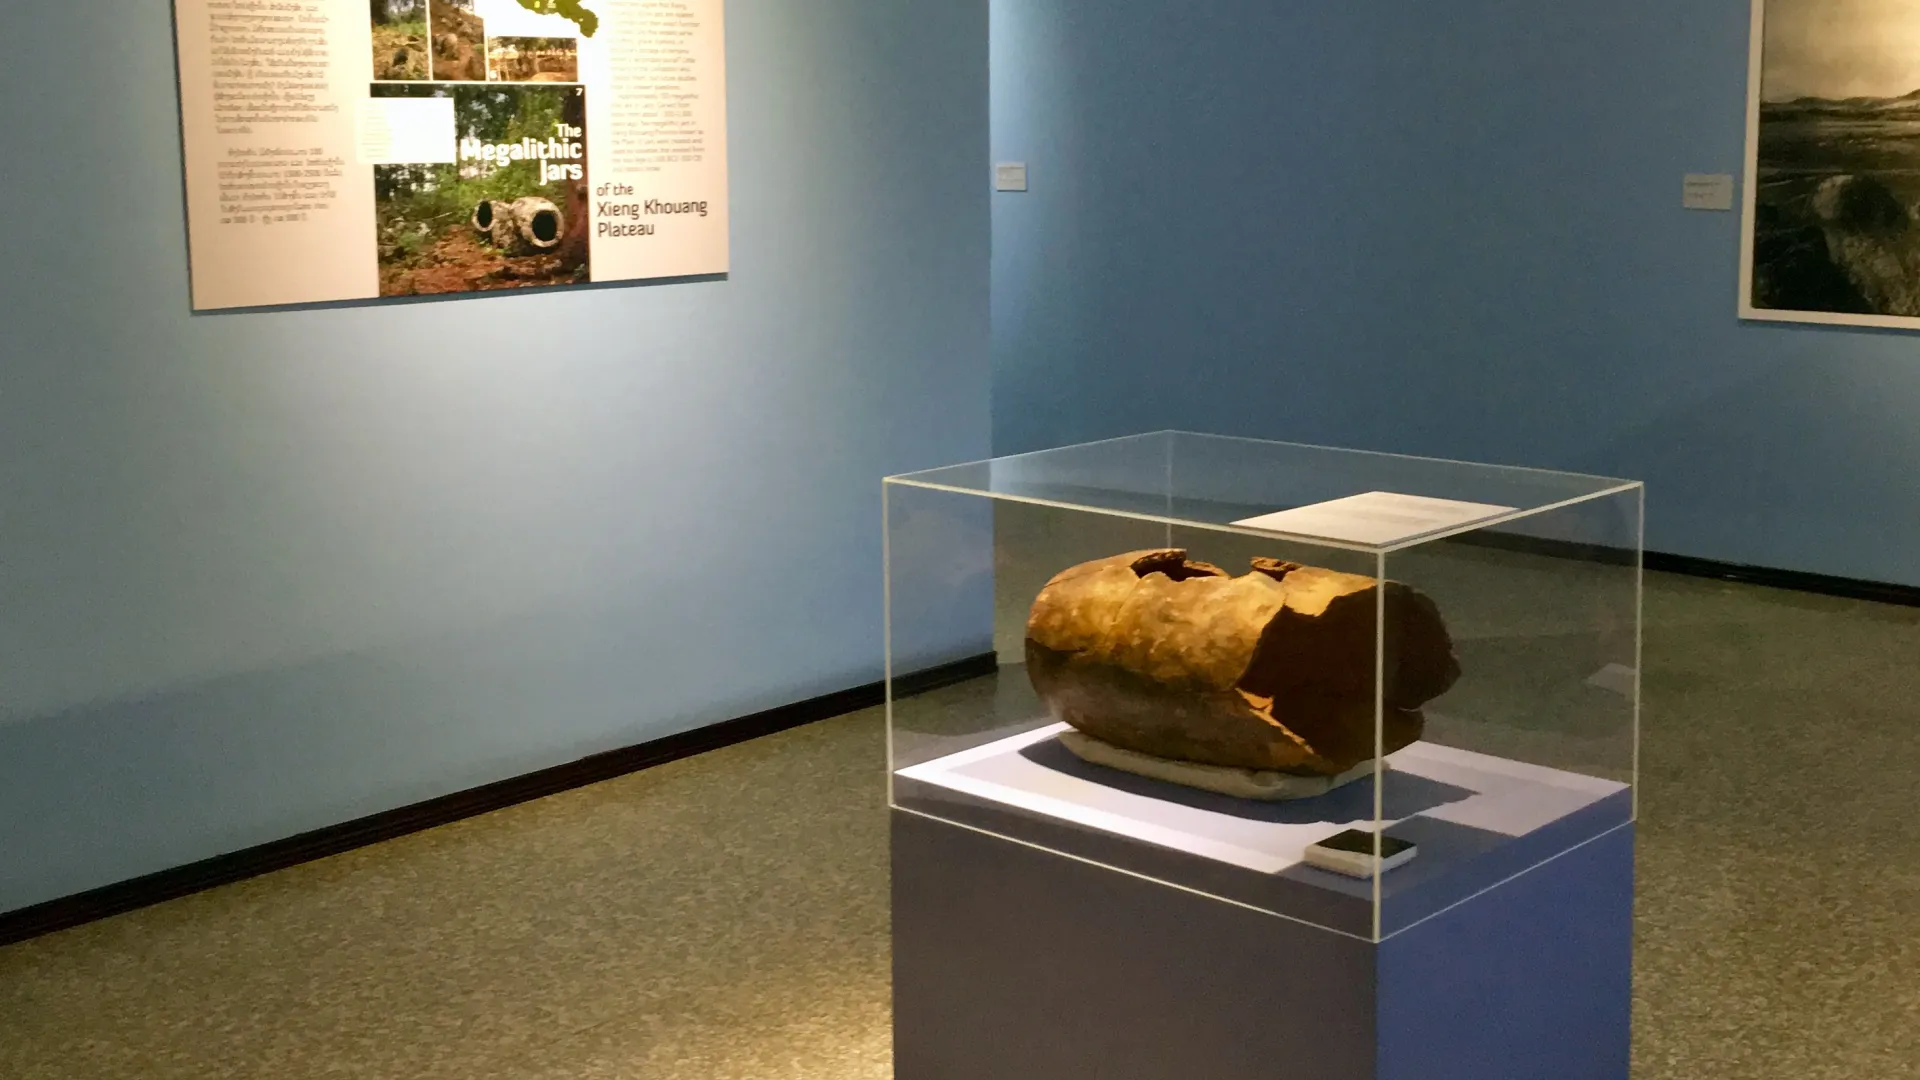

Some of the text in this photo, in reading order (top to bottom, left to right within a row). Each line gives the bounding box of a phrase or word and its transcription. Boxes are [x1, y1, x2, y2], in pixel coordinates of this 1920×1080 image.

[575, 87, 583, 96] 7
[555, 123, 582, 138] The
[460, 136, 583, 167] Megalithic
[540, 160, 583, 185] Jars
[596, 182, 634, 197] of the
[597, 198, 708, 221] Xieng Khouang
[597, 221, 655, 238] Plateau
